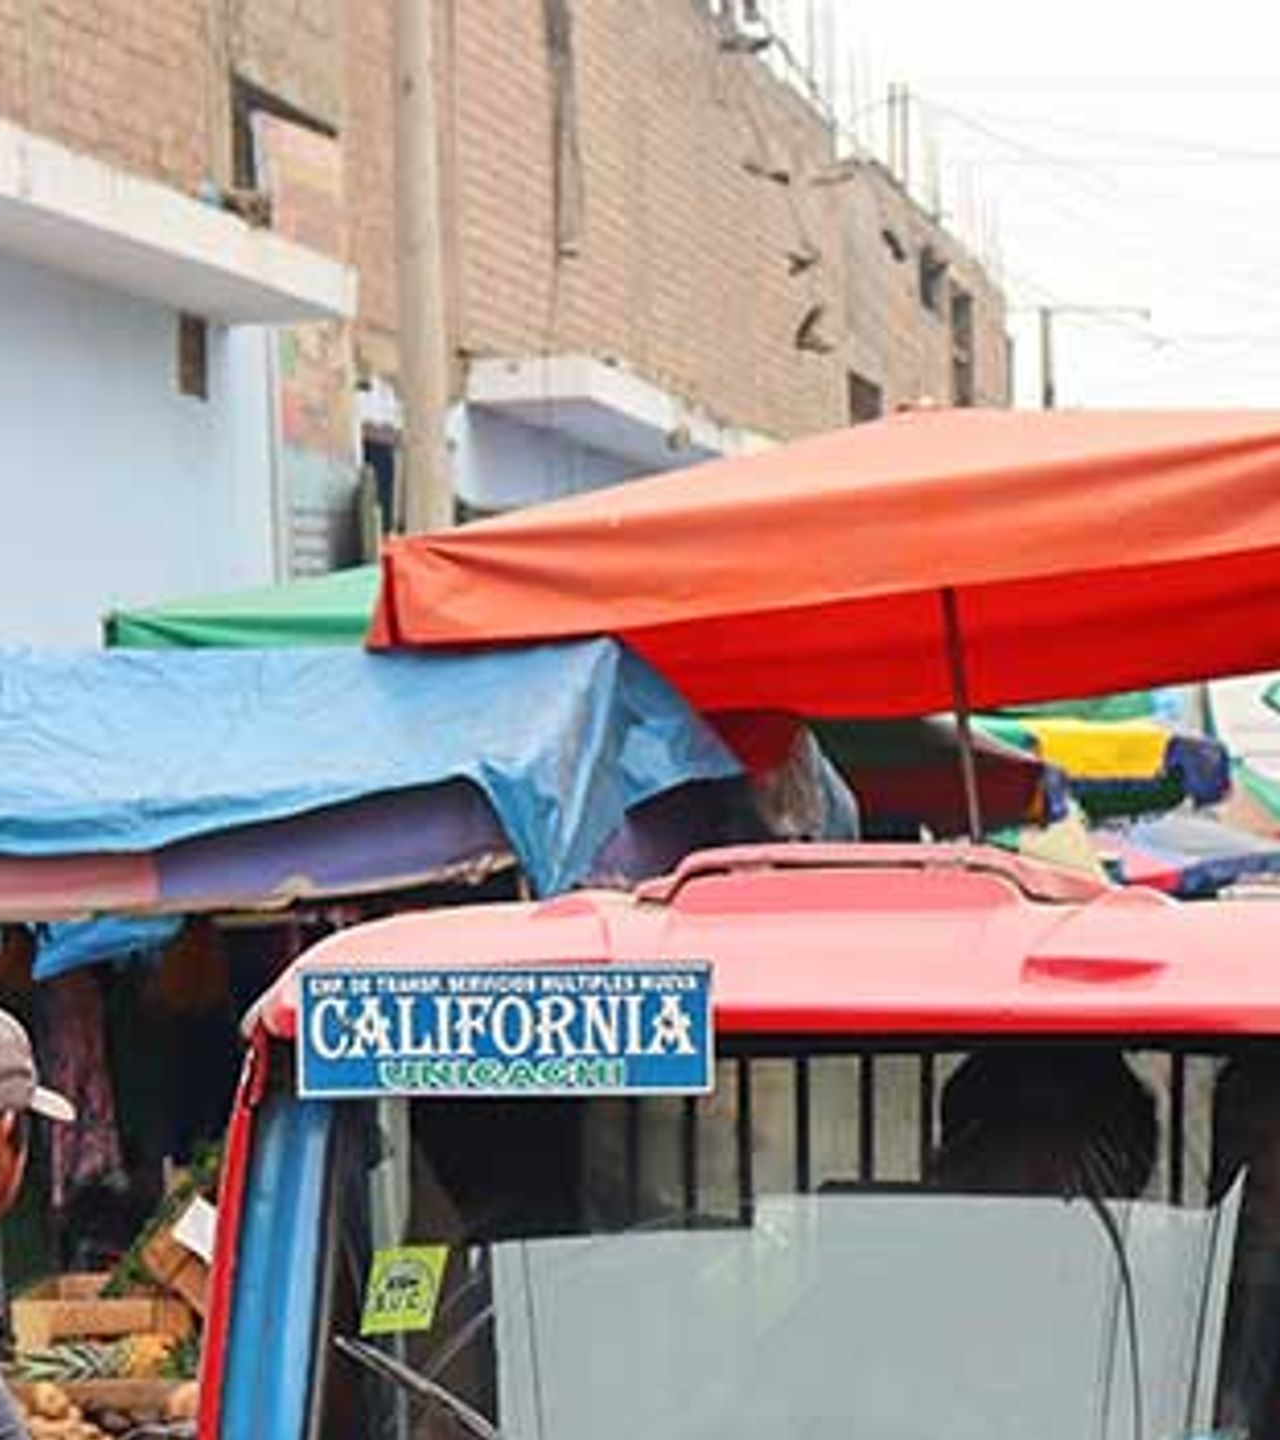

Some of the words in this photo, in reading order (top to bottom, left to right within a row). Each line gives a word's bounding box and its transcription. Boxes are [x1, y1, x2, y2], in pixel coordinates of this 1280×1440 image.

[349, 976, 372, 994] DE
[448, 975, 534, 993] SERVICIOS
[540, 974, 634, 992] MULTIPLES
[639, 973, 697, 991] NUEVA
[310, 993, 697, 1059] CALIFORNIA
[379, 1058, 627, 1089] UNICACHI
